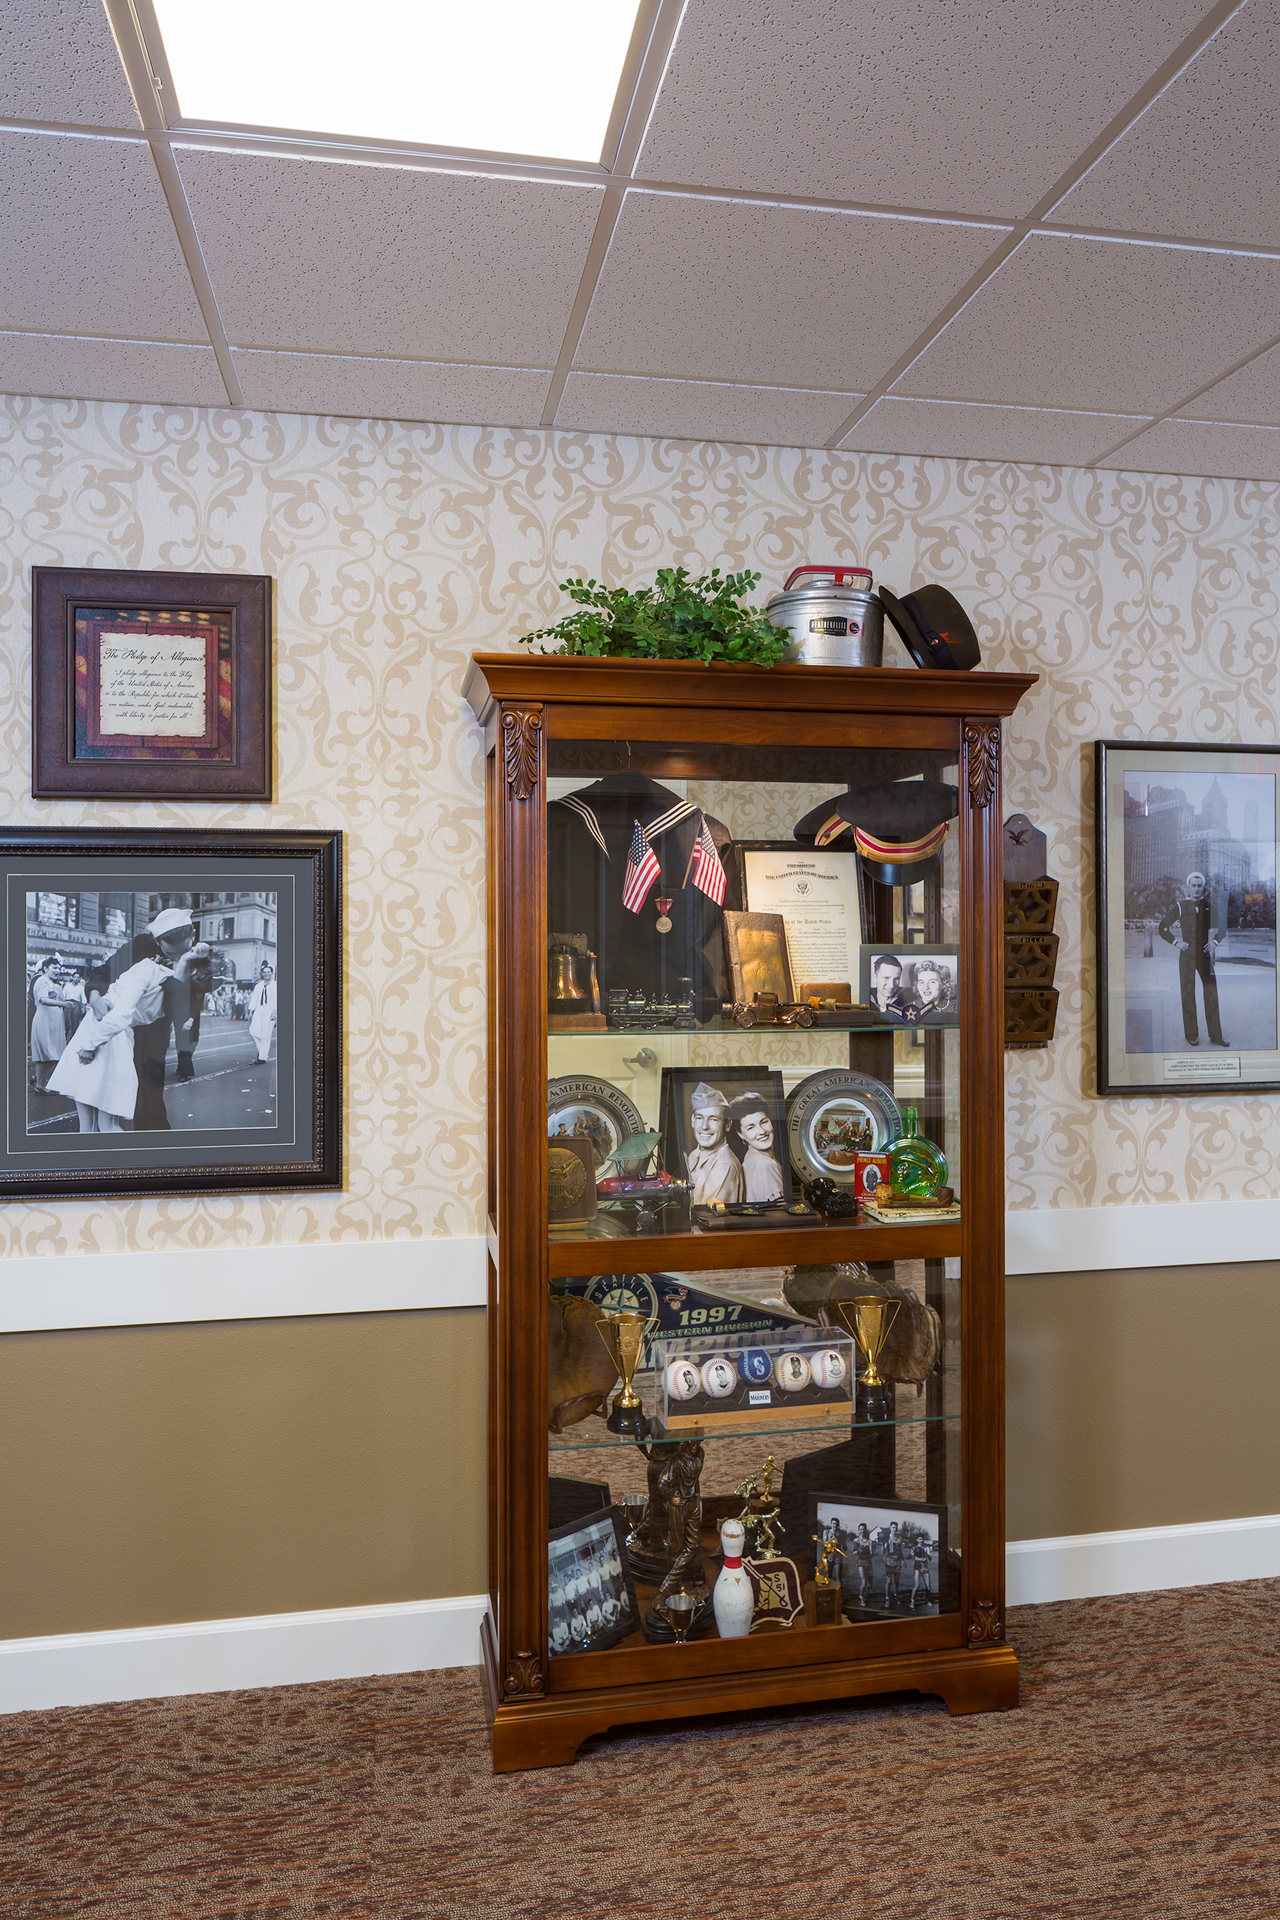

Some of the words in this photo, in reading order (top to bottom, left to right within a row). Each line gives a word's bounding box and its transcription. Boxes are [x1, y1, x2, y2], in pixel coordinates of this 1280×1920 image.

[103, 648, 119, 660] The
[121, 649, 148, 665] Pledge
[150, 651, 161, 664] of
[160, 651, 204, 666] Allegiance
[120, 669, 137, 679] pledge
[139, 669, 161, 679] allegiance
[178, 670, 193, 681] Flag
[110, 680, 118, 688] of
[164, 681, 171, 690] of
[127, 690, 151, 700] Republic
[791, 1112, 802, 1133] THE
[798, 1085, 822, 1111] GREAT
[823, 1076, 872, 1089] AMERICAN
[594, 1273, 649, 1303] SEATTLE
[679, 1304, 743, 1327] 1997
[646, 1325, 713, 1339] WESTERN
[715, 1318, 774, 1334] DIVISION
